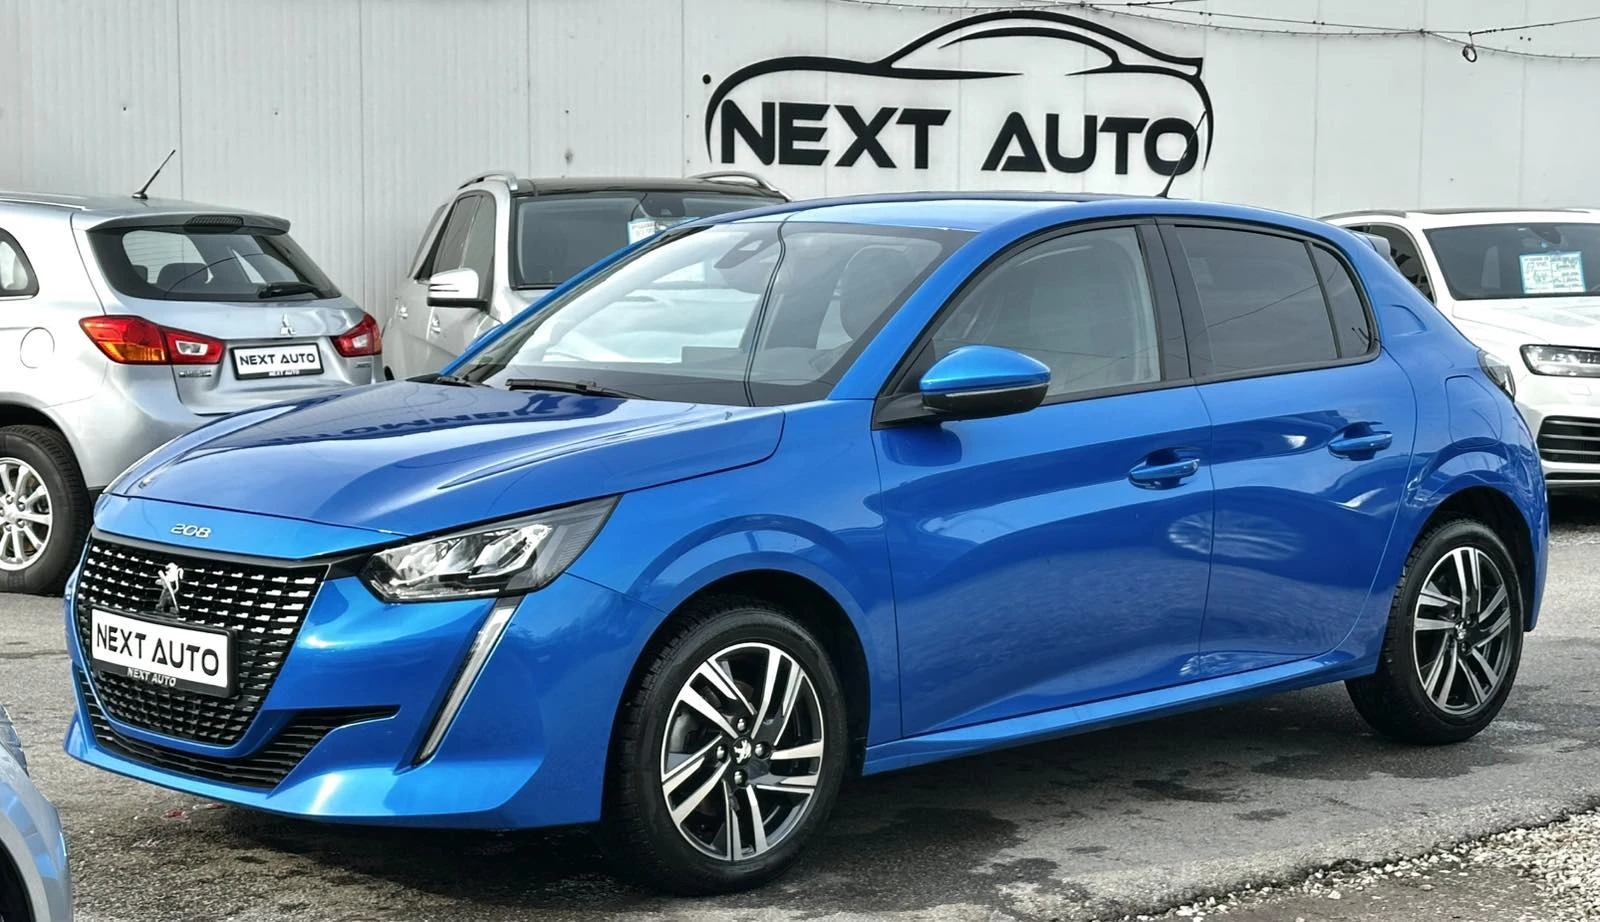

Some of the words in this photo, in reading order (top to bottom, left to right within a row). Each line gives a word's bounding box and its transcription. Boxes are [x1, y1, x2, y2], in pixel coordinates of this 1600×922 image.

[721, 99, 951, 169] NEXT
[981, 111, 1199, 175] AUTO
[240, 353, 275, 365] NEXT
[280, 353, 315, 363] AUTO
[170, 524, 212, 538] 208
[97, 623, 146, 659] NEXT
[152, 638, 219, 676] AUTO
[127, 668, 151, 682] NEXT
[152, 673, 176, 687] AUTO
